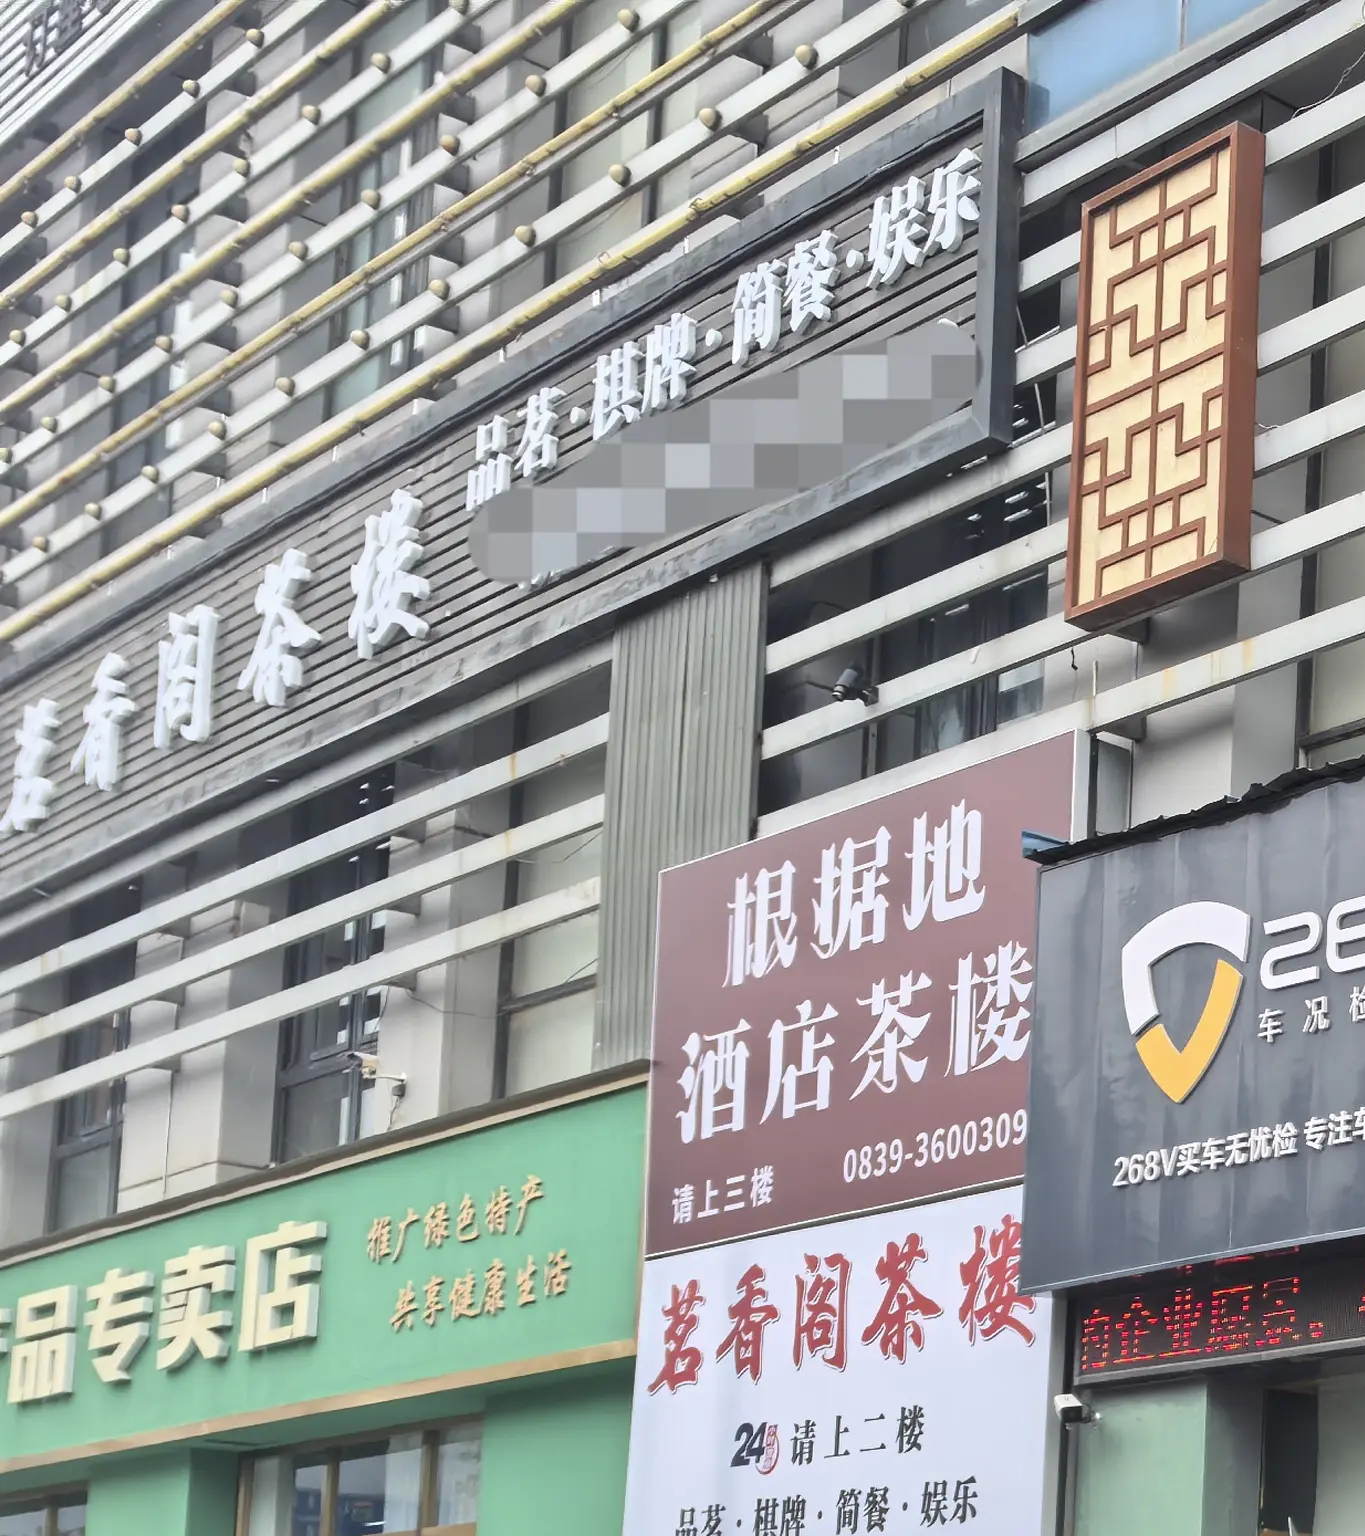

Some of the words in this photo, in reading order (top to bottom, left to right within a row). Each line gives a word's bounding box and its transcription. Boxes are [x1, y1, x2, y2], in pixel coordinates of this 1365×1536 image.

[722, 799, 986, 988] 根据地
[676, 941, 1034, 1144] 酒店茶楼
[842, 1109, 1027, 1184] 0839-3600309
[1112, 1121, 1298, 1187] 268V买车无忧检
[367, 1175, 544, 1262] 推广绿色特产
[672, 1165, 774, 1224] 请上三楼
[0, 1220, 327, 1403] 品专卖店
[389, 1249, 571, 1332] 共享健康生活
[648, 1214, 1037, 1397] 茗香阁茶楼
[790, 1405, 925, 1466] 请上二楼
